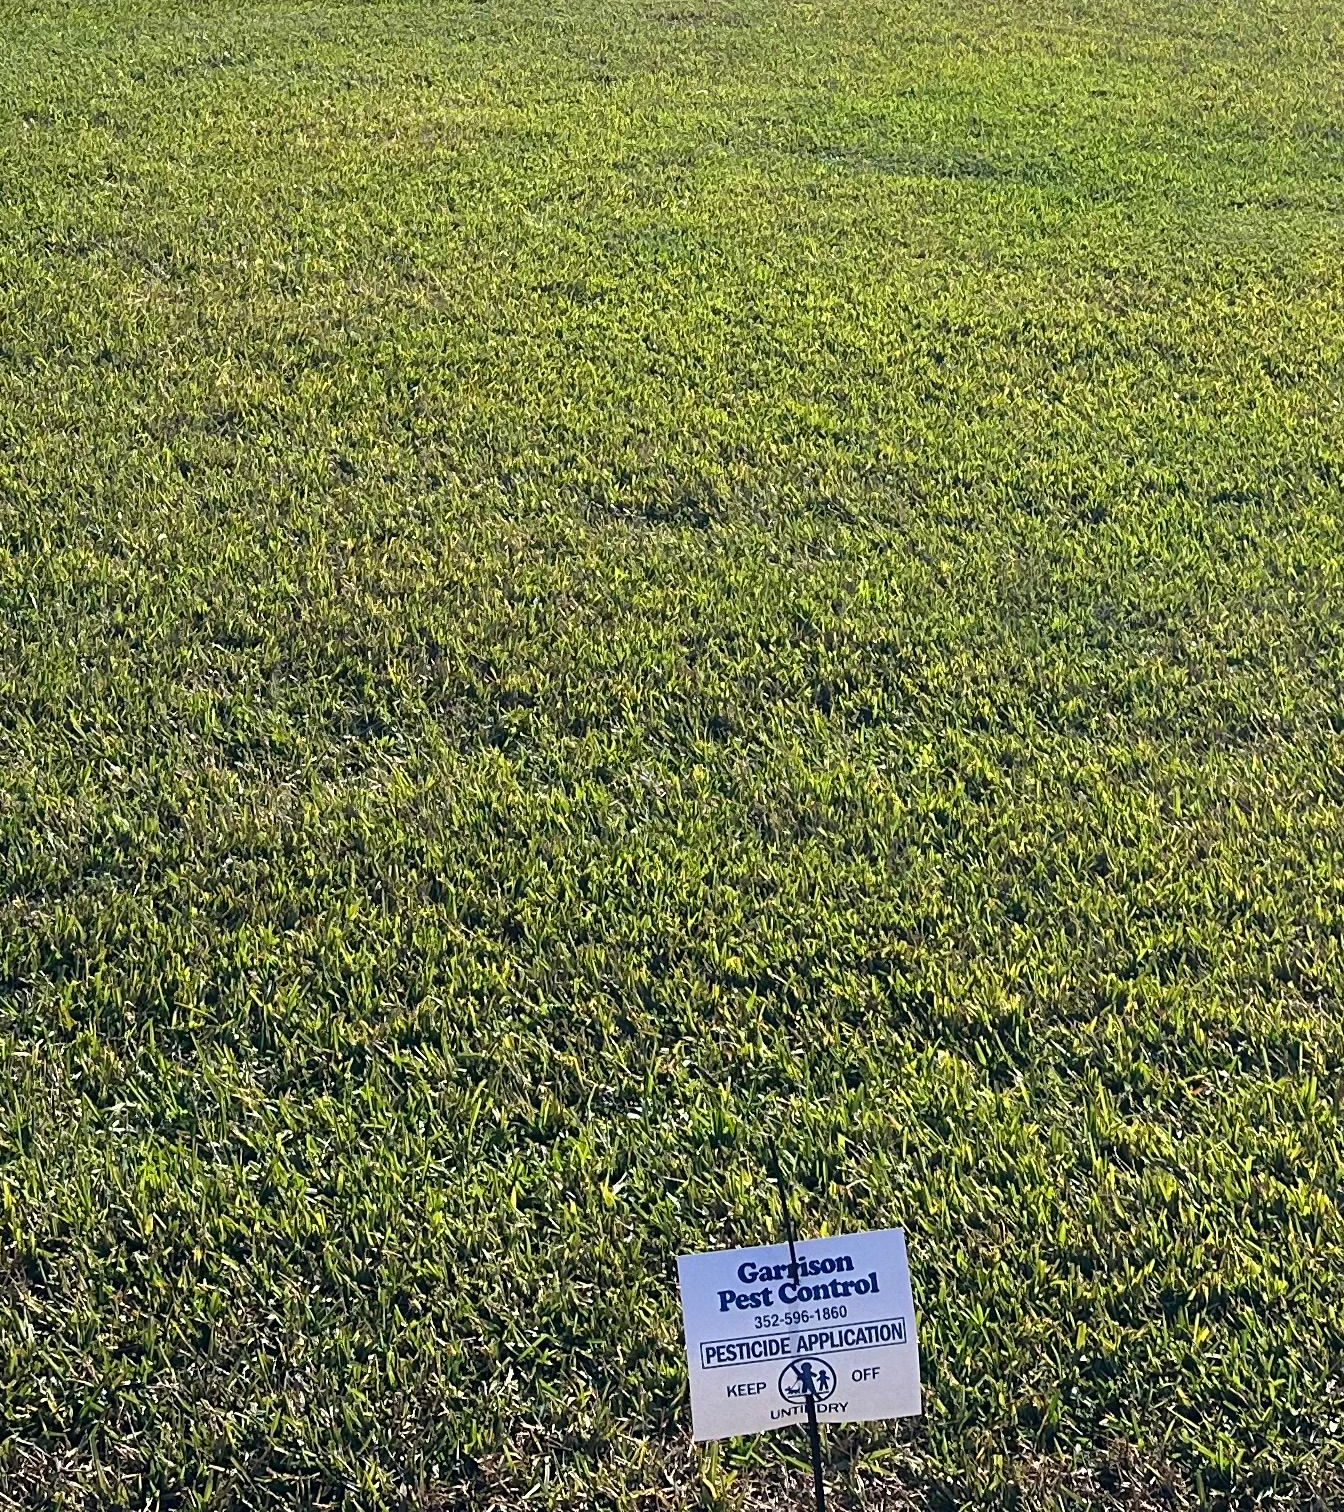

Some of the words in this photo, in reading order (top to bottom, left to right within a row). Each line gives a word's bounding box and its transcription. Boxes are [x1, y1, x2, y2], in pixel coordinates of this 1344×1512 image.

[718, 1287, 774, 1312] Pest
[779, 1273, 879, 1304] Control
[754, 1306, 847, 1329] 352-596-1860
[705, 1337, 790, 1364] PESTICIDE
[797, 1322, 903, 1353] APPLICATION
[727, 1382, 766, 1397] KEEP
[852, 1367, 881, 1382] OFF
[817, 1402, 848, 1413] DRY
